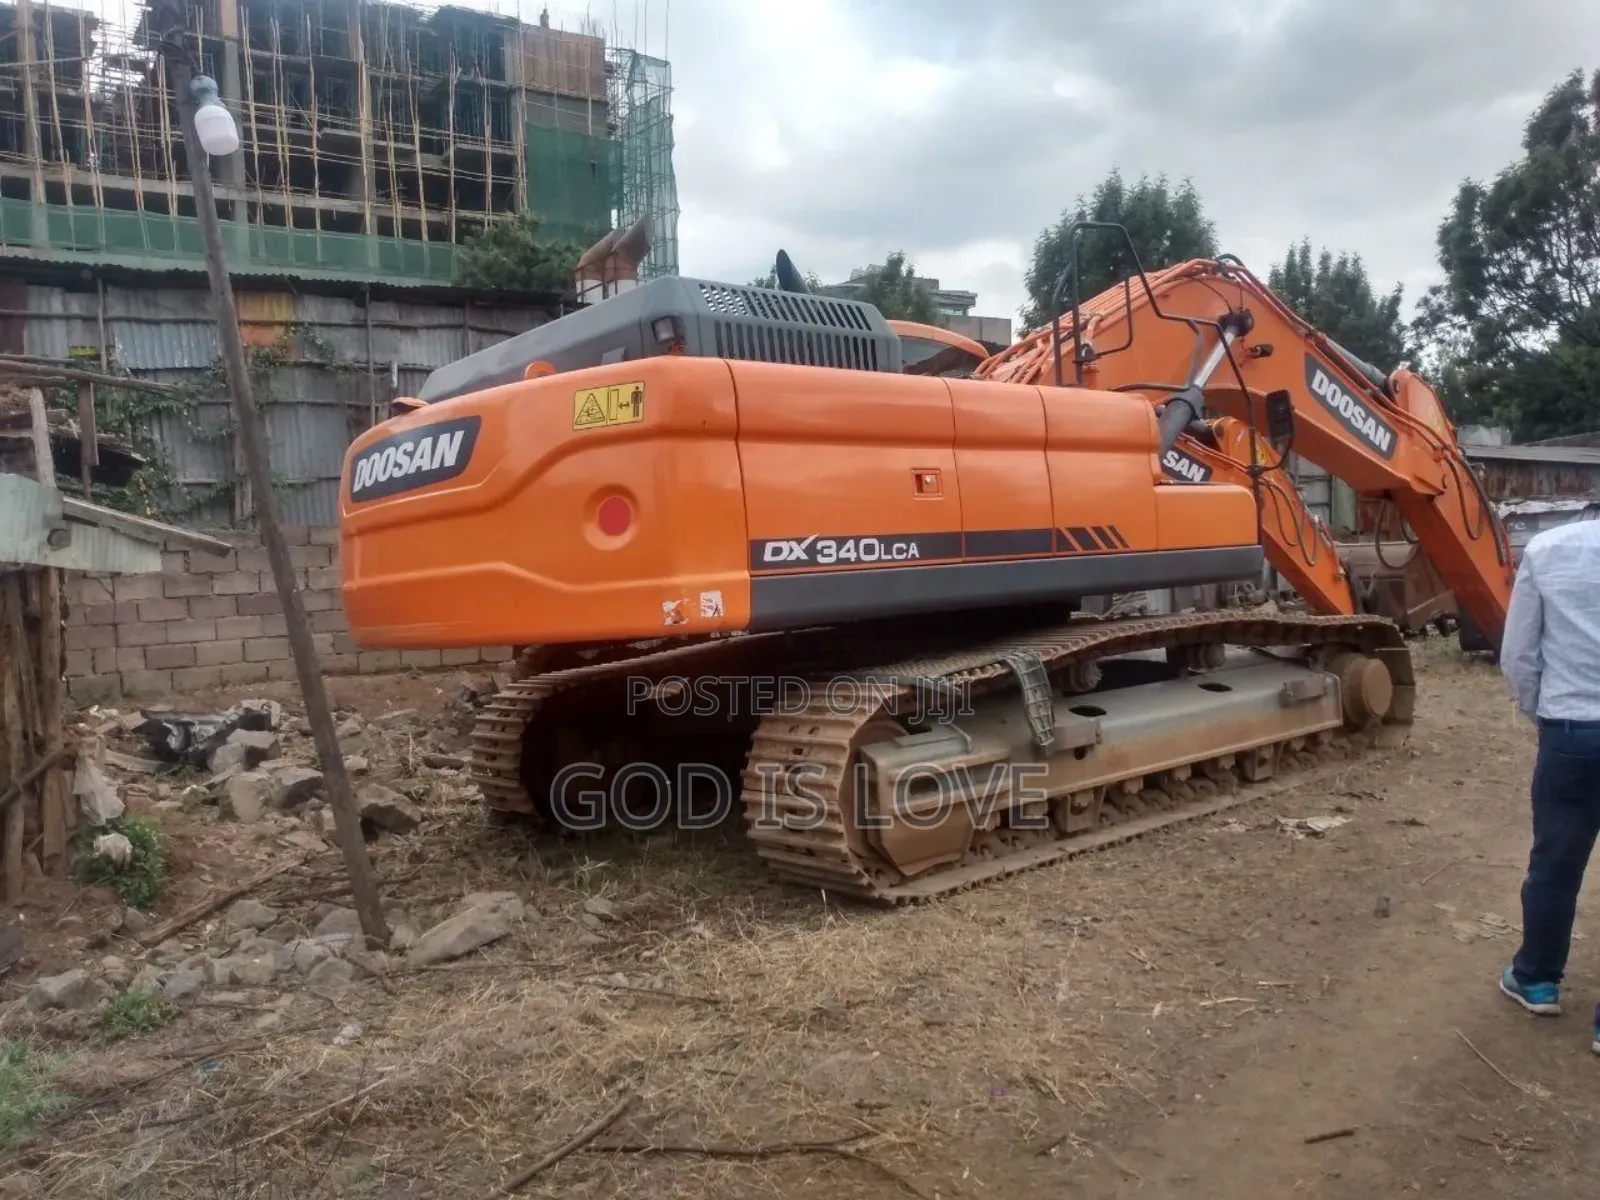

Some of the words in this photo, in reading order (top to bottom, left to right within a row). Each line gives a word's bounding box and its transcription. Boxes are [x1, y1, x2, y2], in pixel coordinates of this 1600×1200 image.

[1311, 369, 1391, 452] DOOSAN
[353, 430, 465, 493] DOOSAN
[1163, 450, 1206, 482] SAN
